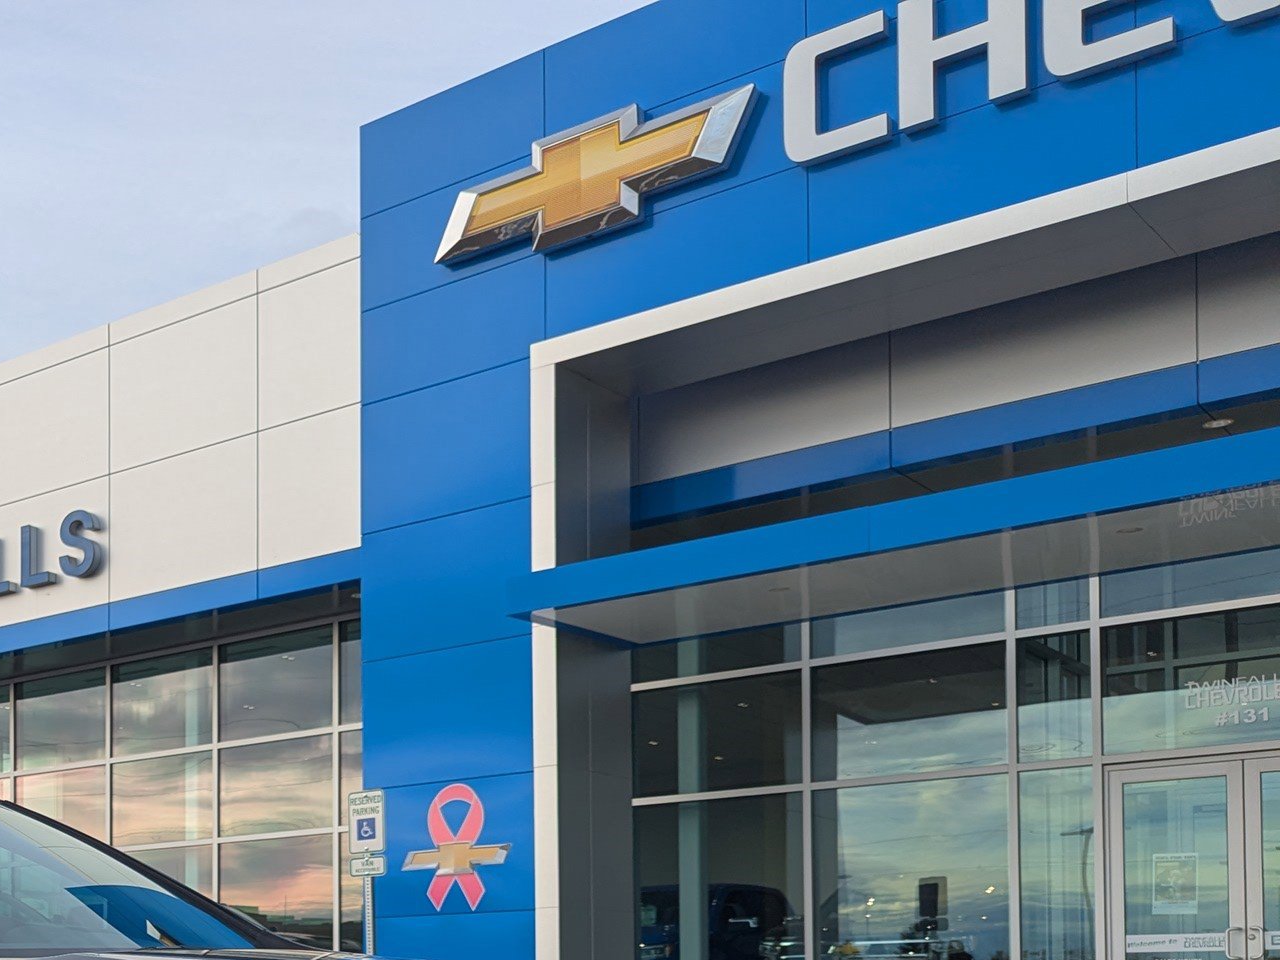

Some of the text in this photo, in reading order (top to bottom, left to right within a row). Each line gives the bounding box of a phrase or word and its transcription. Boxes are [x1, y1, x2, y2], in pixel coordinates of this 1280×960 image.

[1216, 707, 1269, 726] #131
[350, 795, 382, 807] RESERVED
[352, 806, 380, 817] PARKING
